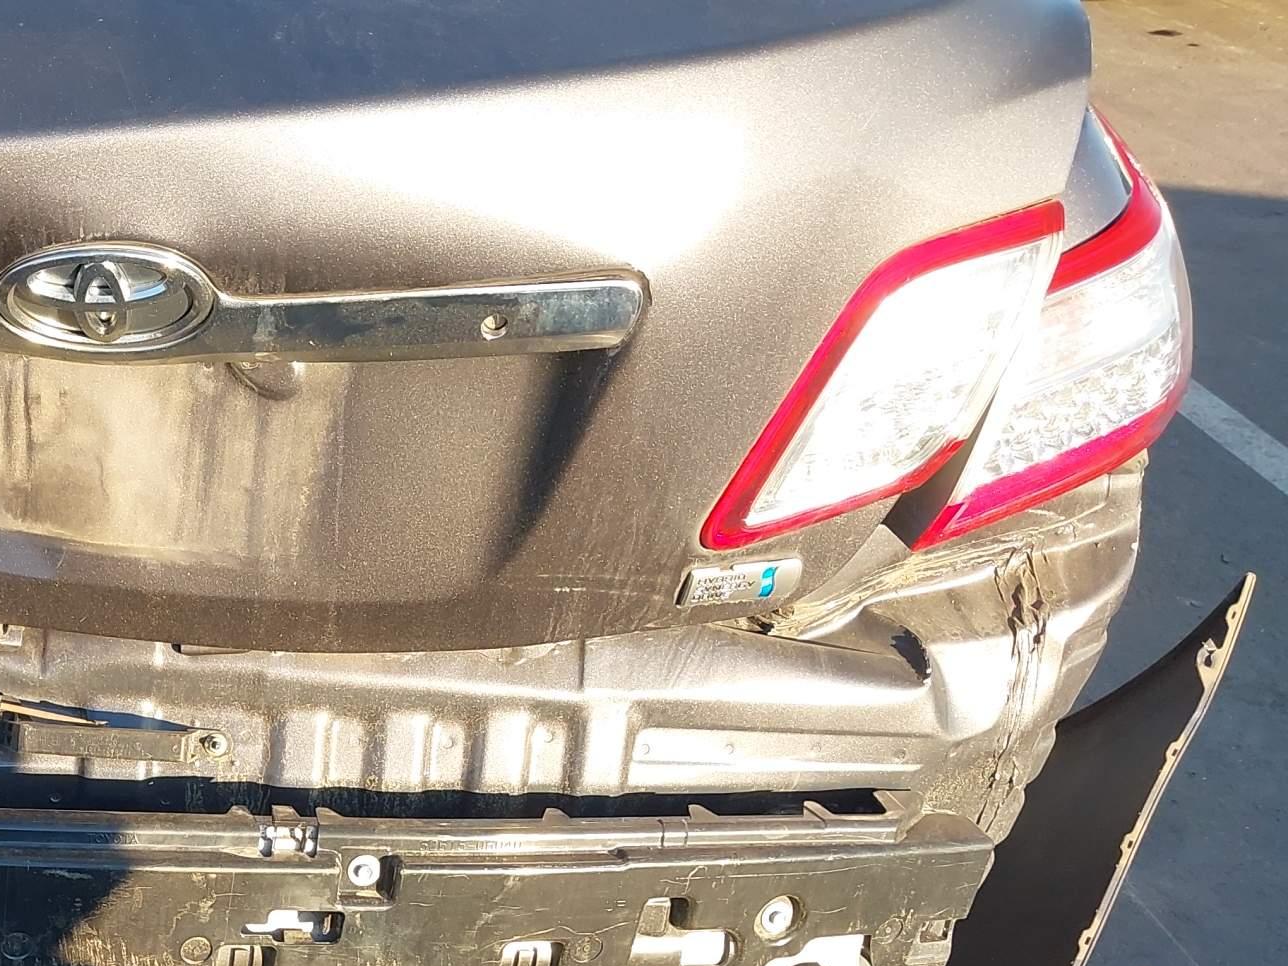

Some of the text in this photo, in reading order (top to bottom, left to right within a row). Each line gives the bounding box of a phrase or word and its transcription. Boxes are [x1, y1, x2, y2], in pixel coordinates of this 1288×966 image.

[697, 573, 746, 585] HYBRID
[695, 580, 755, 592] SYNERGY
[87, 832, 140, 845] TOYOTA
